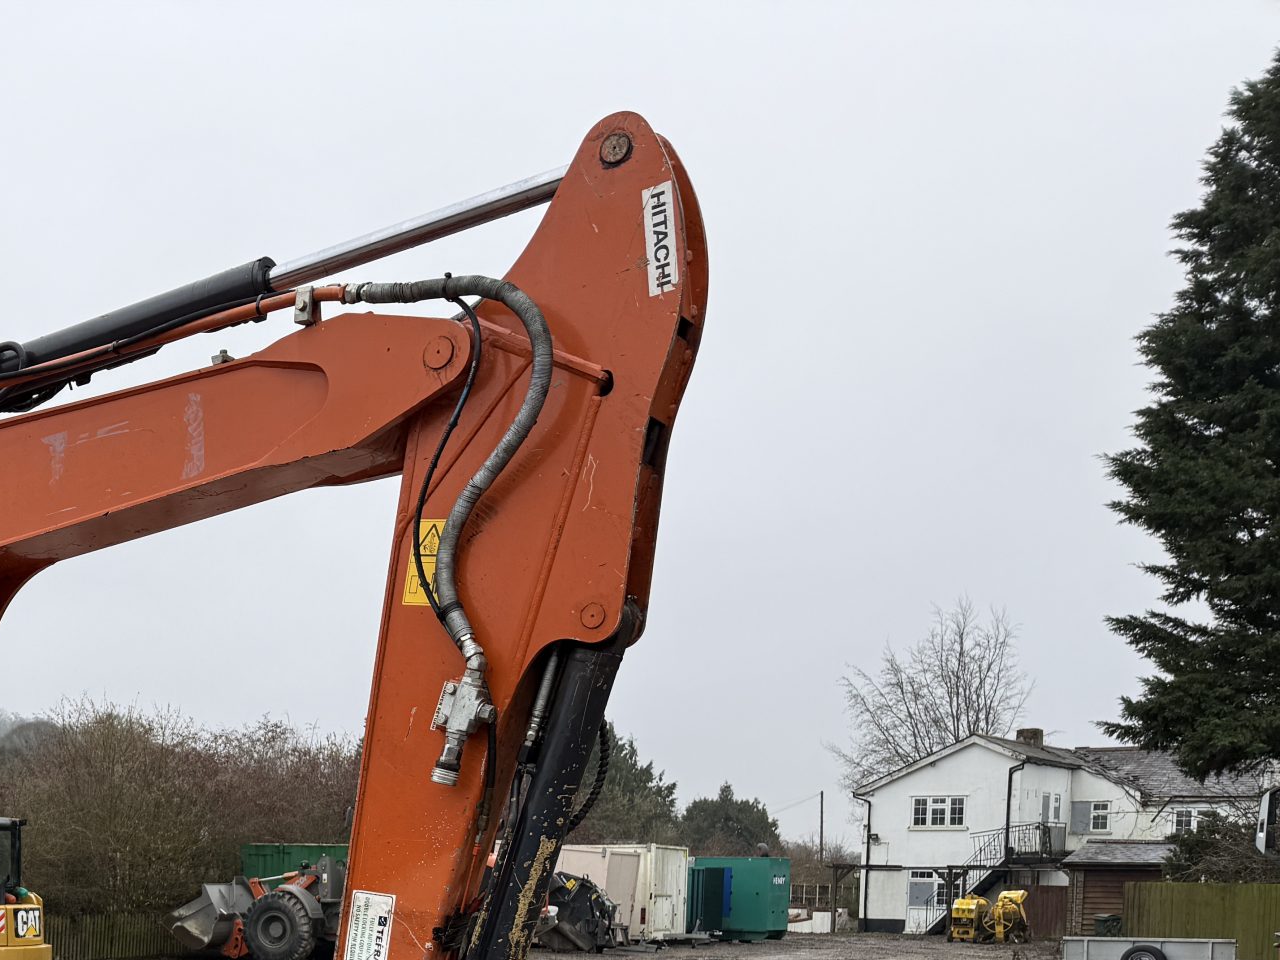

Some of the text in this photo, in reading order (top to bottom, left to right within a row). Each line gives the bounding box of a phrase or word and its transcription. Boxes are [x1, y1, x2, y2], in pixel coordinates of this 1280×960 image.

[651, 190, 672, 288] HITACHI
[17, 910, 40, 937] CAT
[360, 917, 368, 939] LOCKING
[365, 933, 373, 960] AUTOMA
